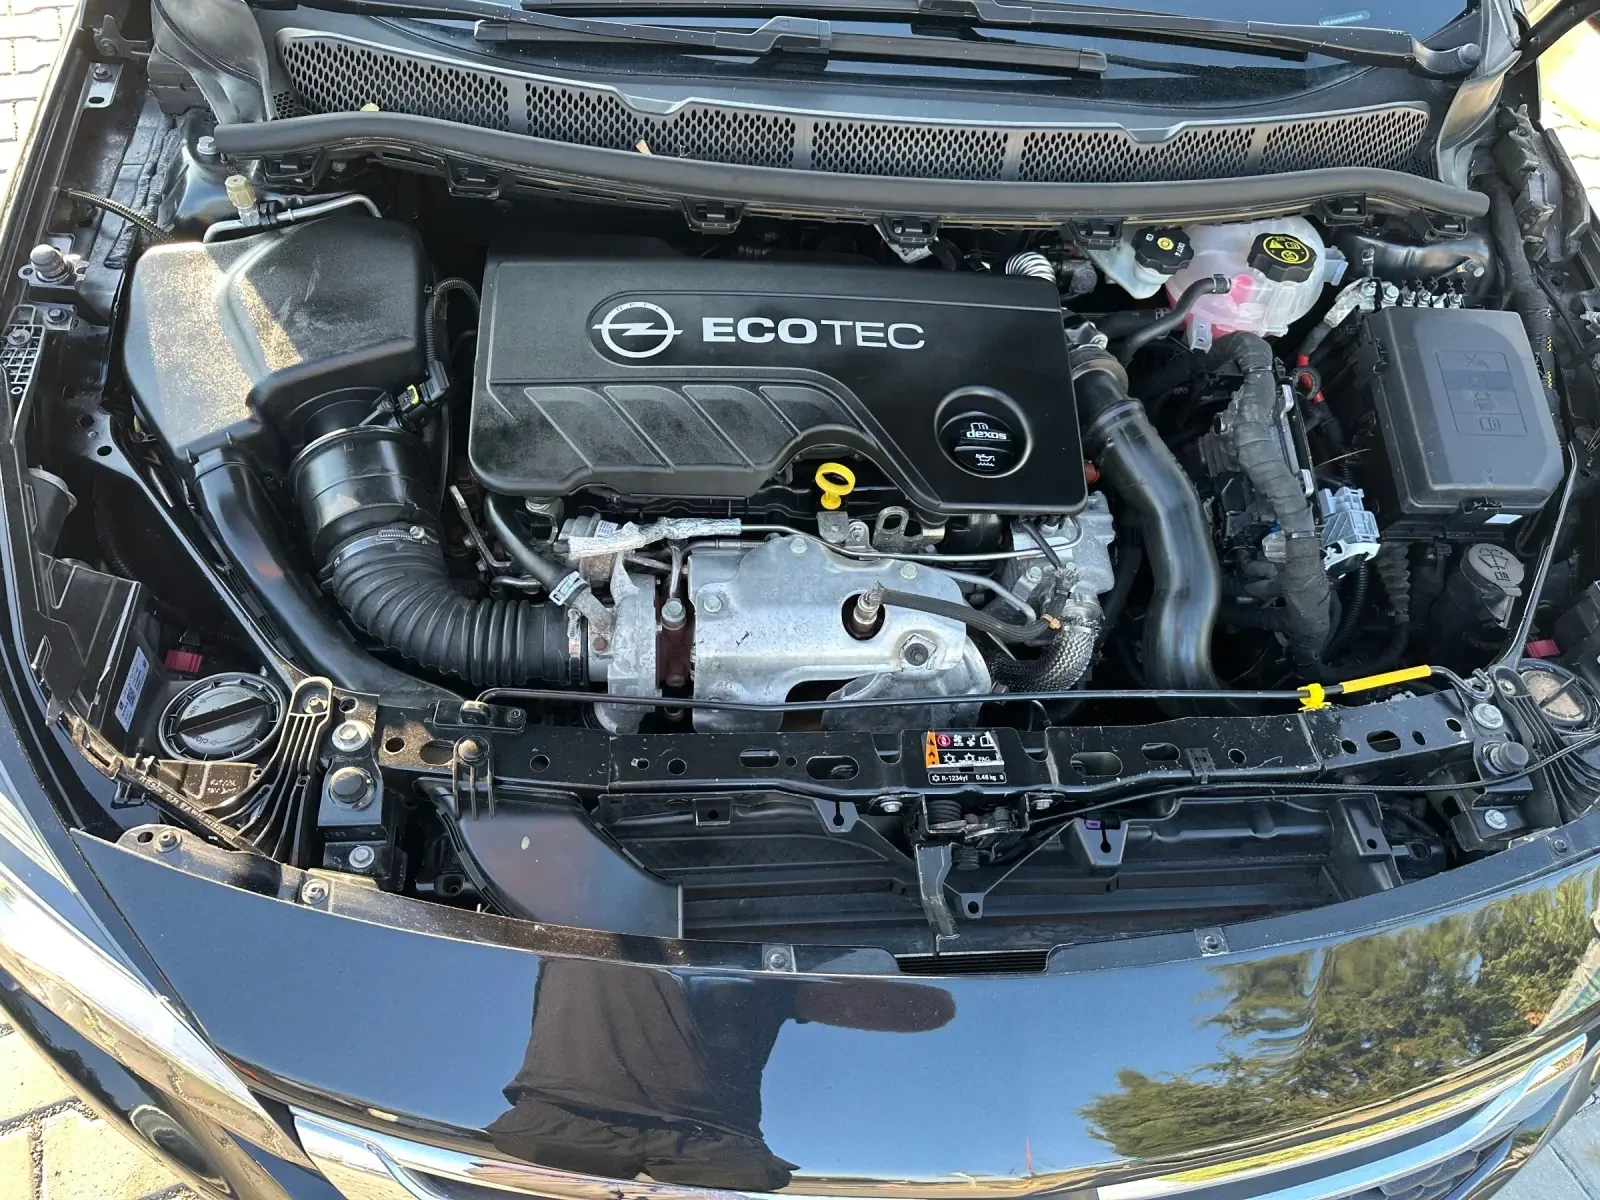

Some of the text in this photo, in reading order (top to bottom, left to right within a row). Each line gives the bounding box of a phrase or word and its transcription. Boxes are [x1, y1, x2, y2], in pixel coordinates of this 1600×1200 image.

[1176, 242, 1186, 253] DOT
[616, 302, 659, 312] OPEL
[701, 316, 925, 350] ECOTEC
[966, 429, 1007, 440] dexos
[941, 774, 969, 782] R-1234yf
